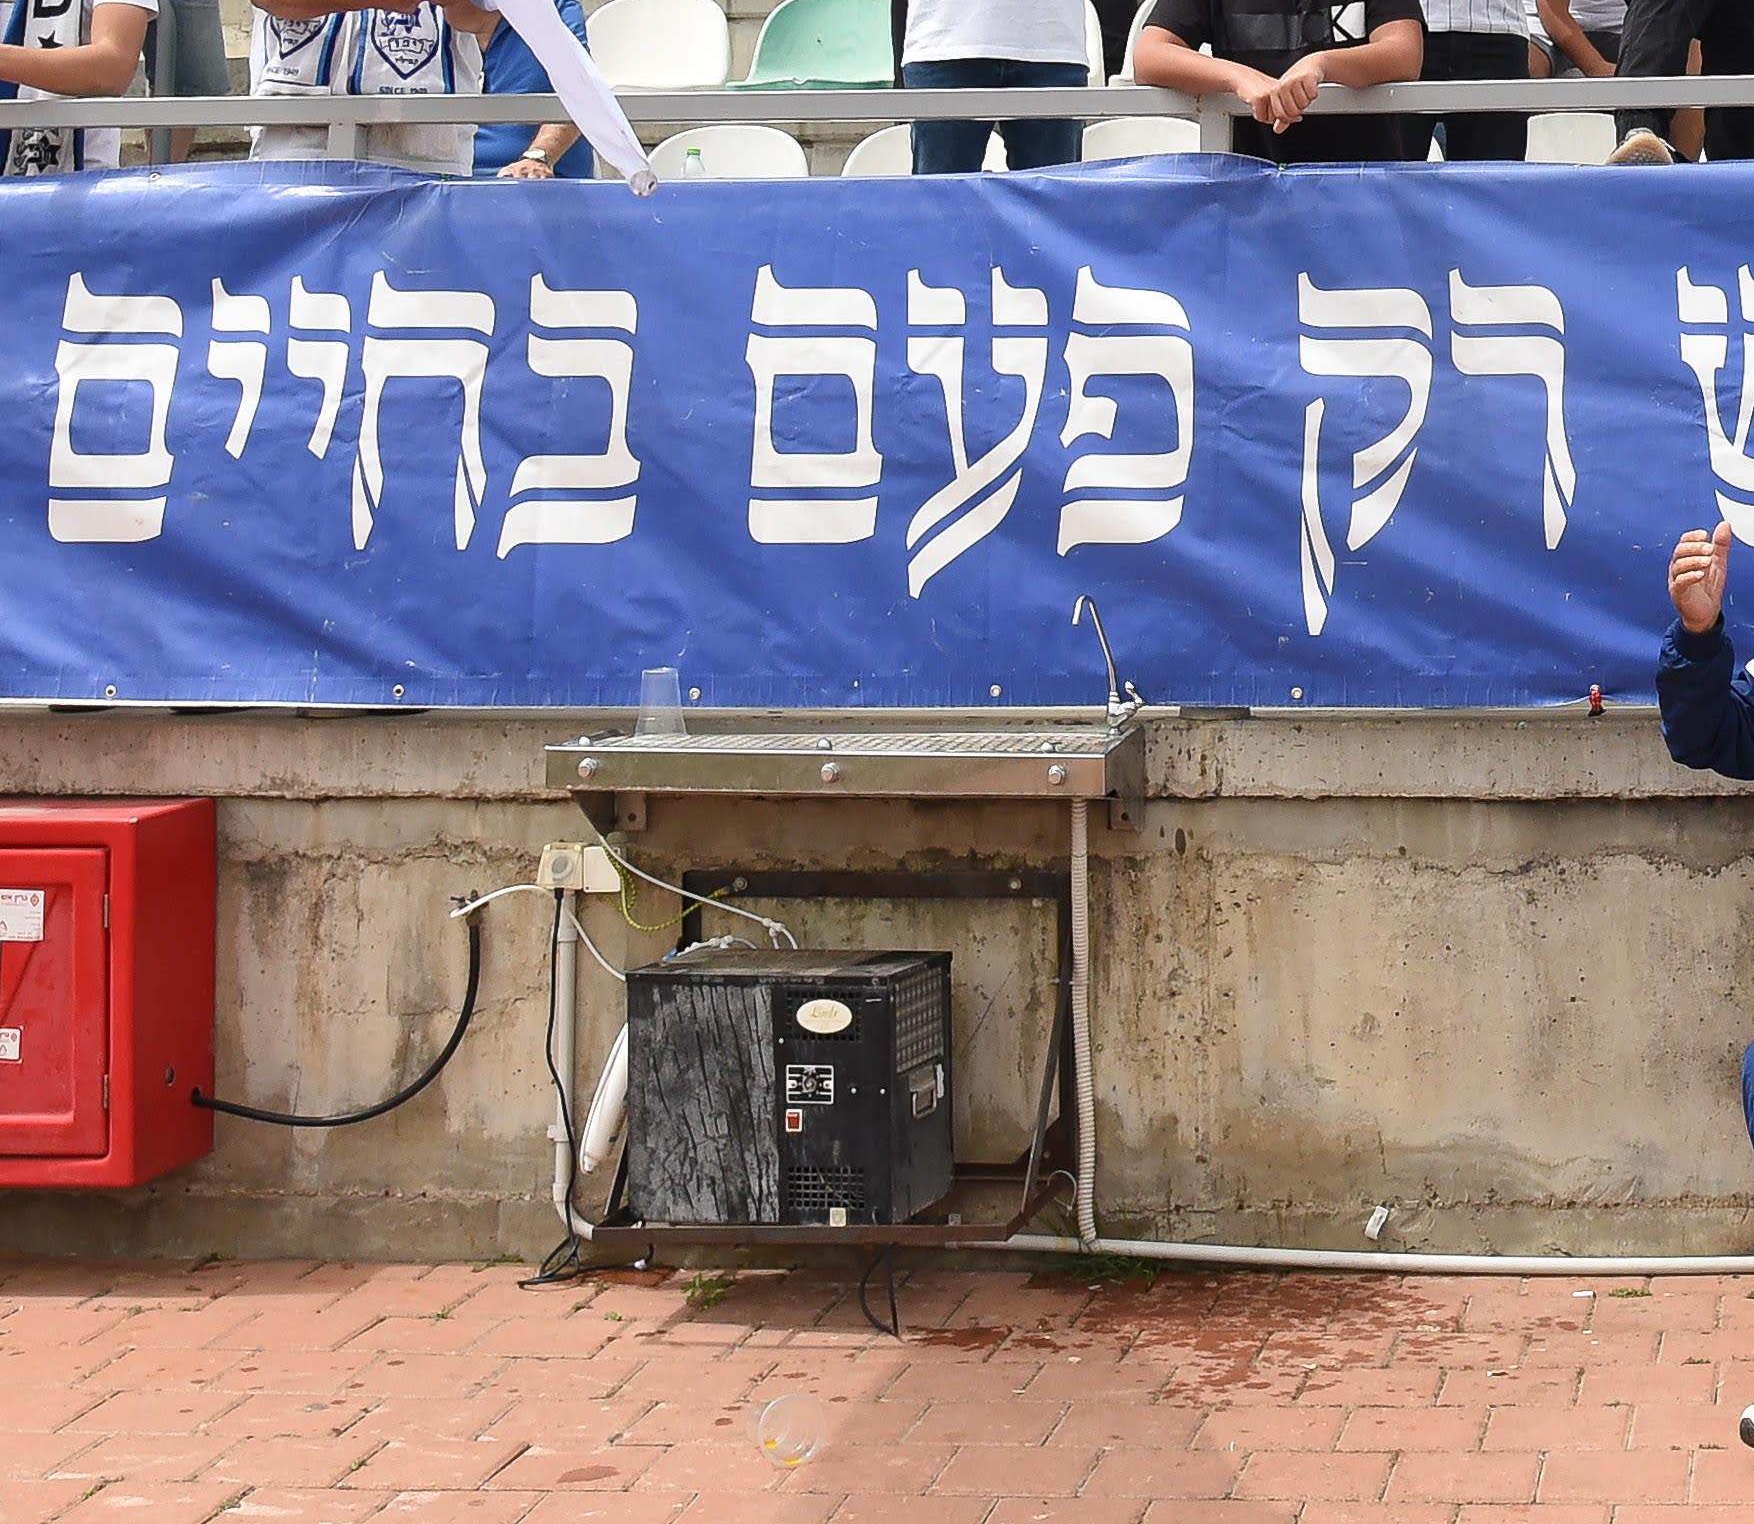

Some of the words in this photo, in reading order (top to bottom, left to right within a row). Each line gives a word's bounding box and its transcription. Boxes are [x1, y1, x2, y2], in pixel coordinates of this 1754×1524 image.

[48, 269, 641, 560] בחיים
[746, 264, 1194, 599] פעם
[1297, 267, 1577, 637] רק
